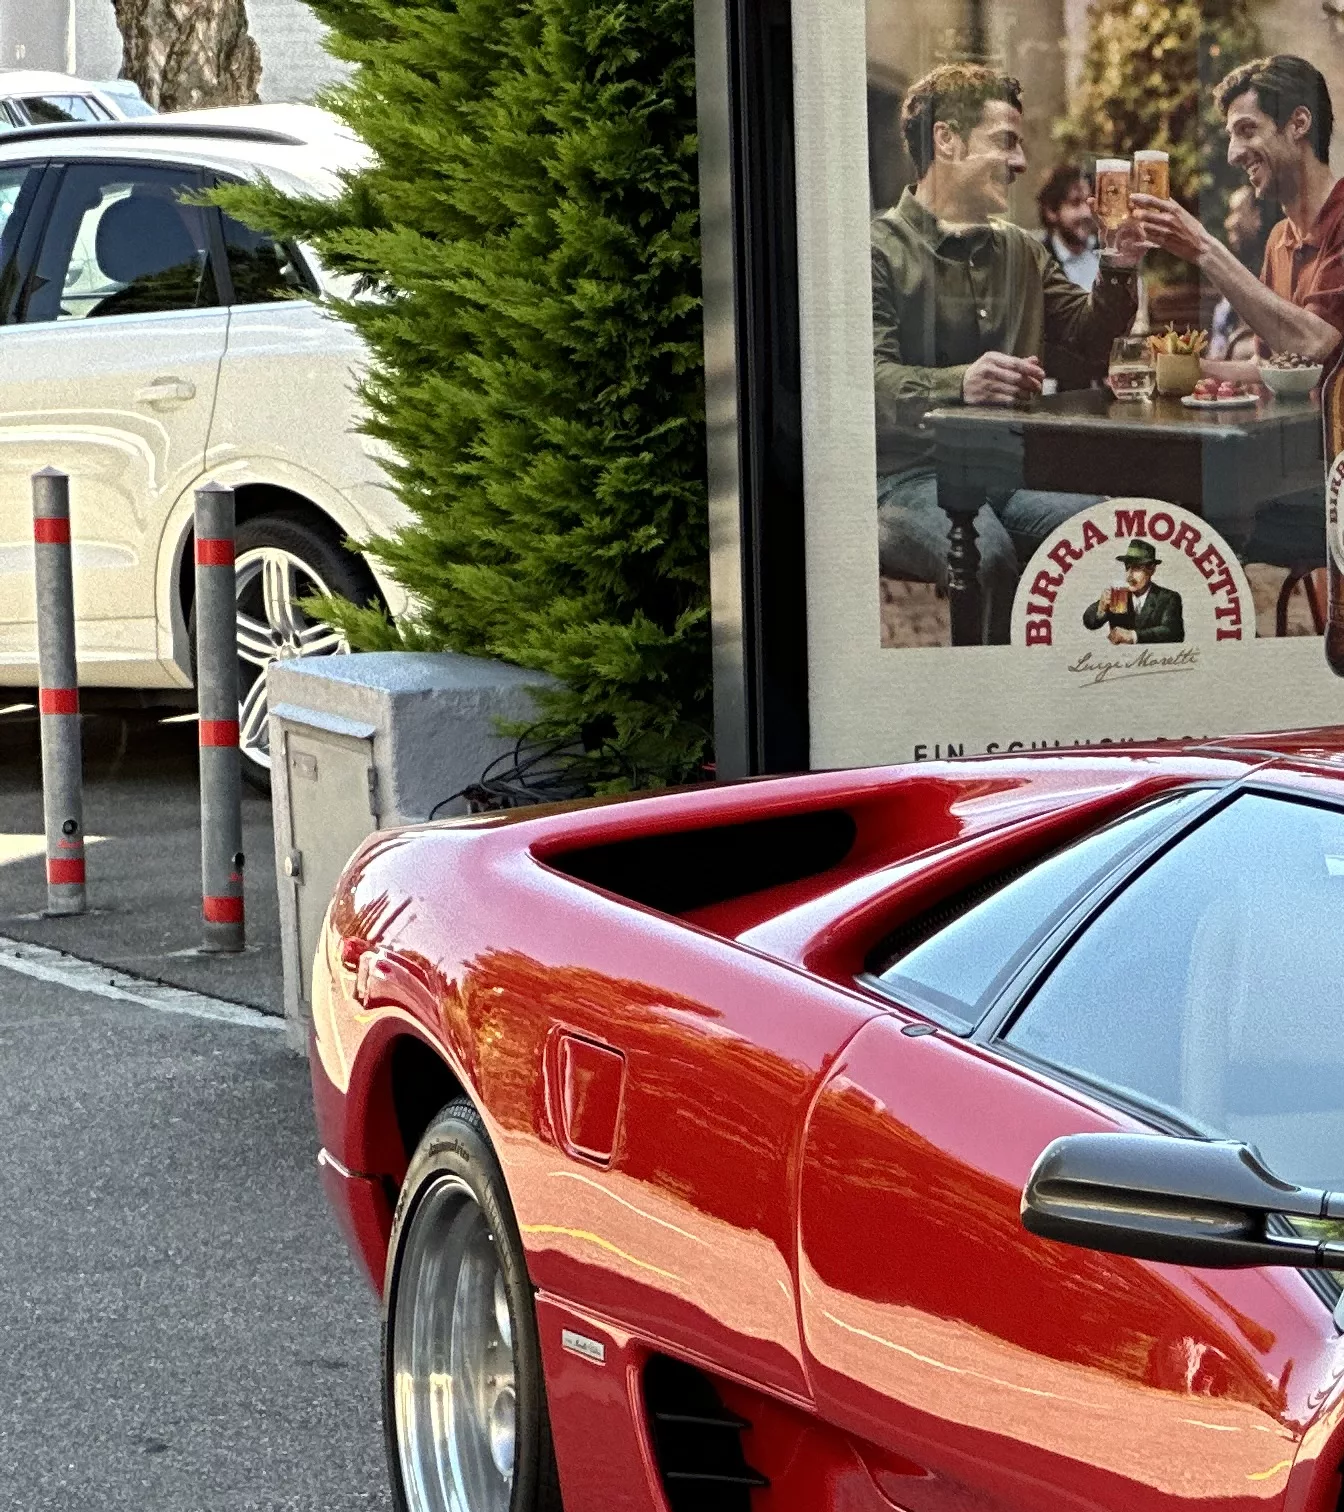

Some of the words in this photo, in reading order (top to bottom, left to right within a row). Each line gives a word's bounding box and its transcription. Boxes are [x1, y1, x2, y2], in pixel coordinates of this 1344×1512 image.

[1025, 519, 1109, 647] BIRRA
[1113, 509, 1243, 642] MORETTI
[1124, 647, 1200, 669] Moretti
[914, 743, 965, 762] EIN
